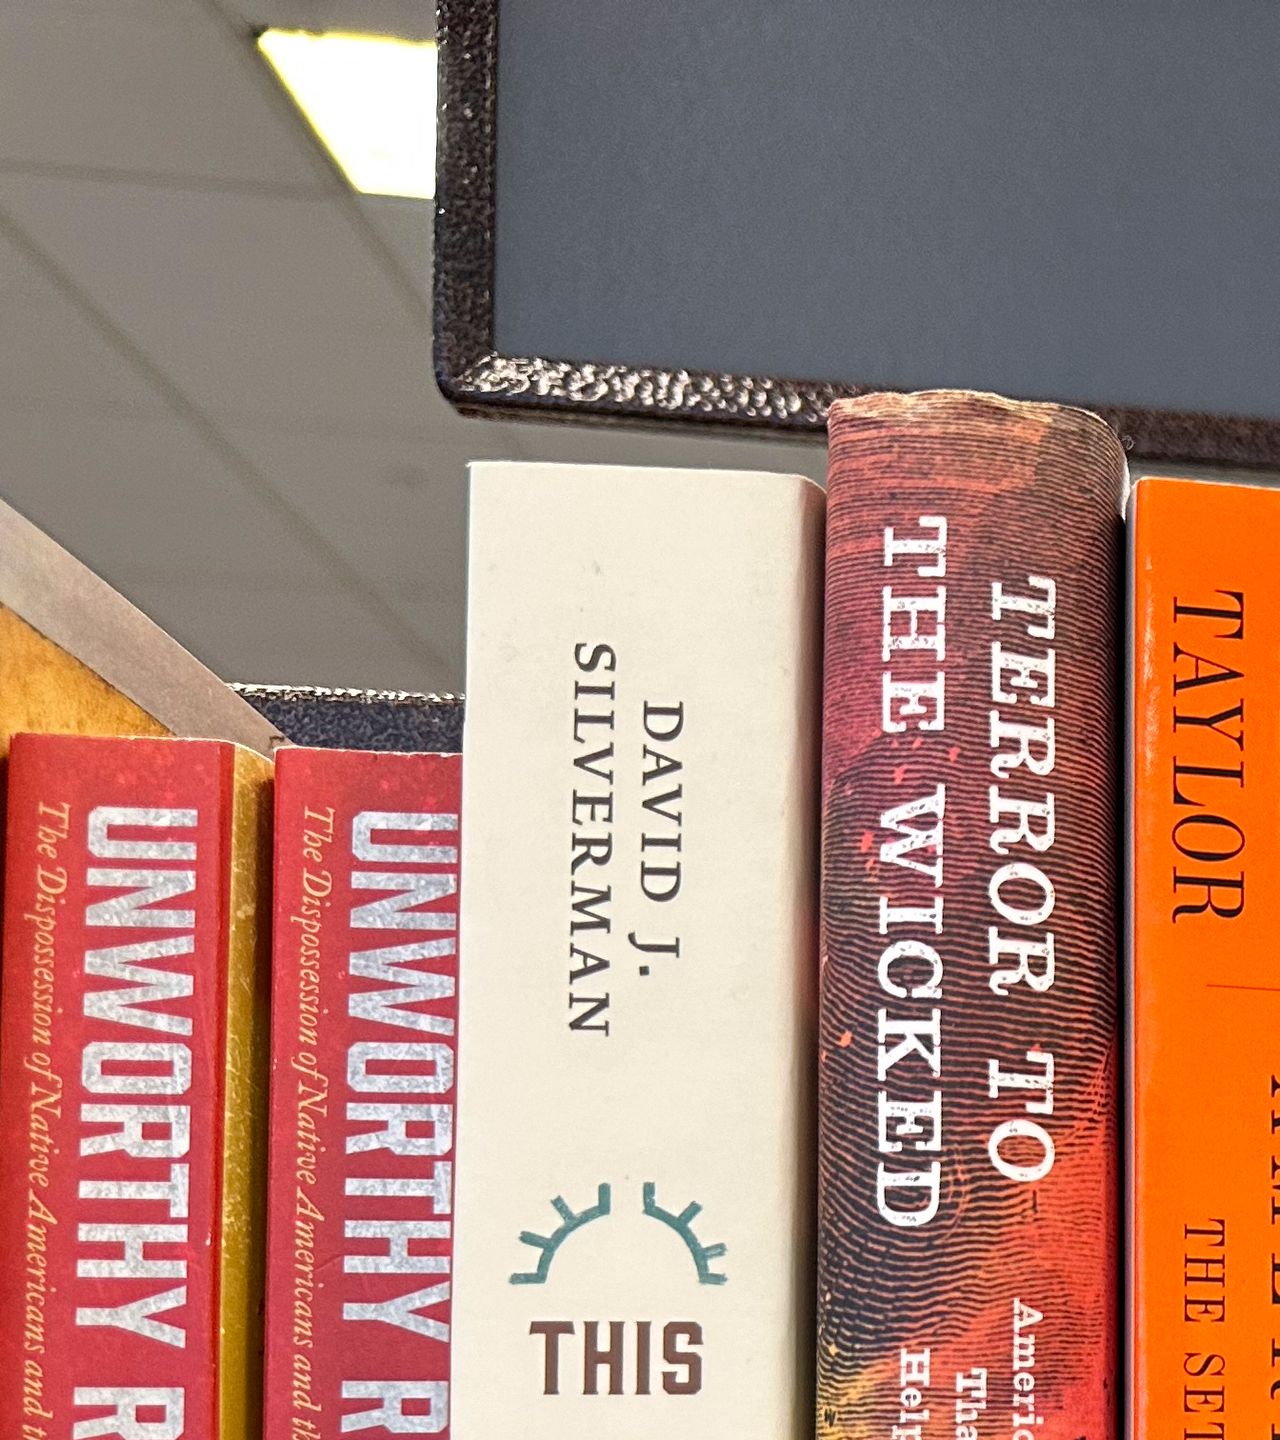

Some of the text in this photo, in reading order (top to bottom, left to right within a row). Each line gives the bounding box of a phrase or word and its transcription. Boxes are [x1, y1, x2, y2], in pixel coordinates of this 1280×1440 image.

[303, 806, 336, 863] The
[567, 641, 617, 1038] SILVERMAN
[627, 699, 686, 978] DAVID J.
[1170, 590, 1246, 925] TAYLOR
[289, 869, 333, 1044] Dispossession
[875, 513, 947, 1229] THE WICKED
[986, 574, 1058, 1183] TERROR TO
[75, 804, 199, 1352] UNWORTHY
[291, 1056, 329, 1090] of
[296, 1080, 329, 1185] Native
[338, 808, 460, 1346] UNWORTHY
[292, 1186, 325, 1349] Americans
[1182, 1218, 1226, 1324] THE
[291, 1353, 323, 1412] and
[529, 1320, 704, 1397] THIS
